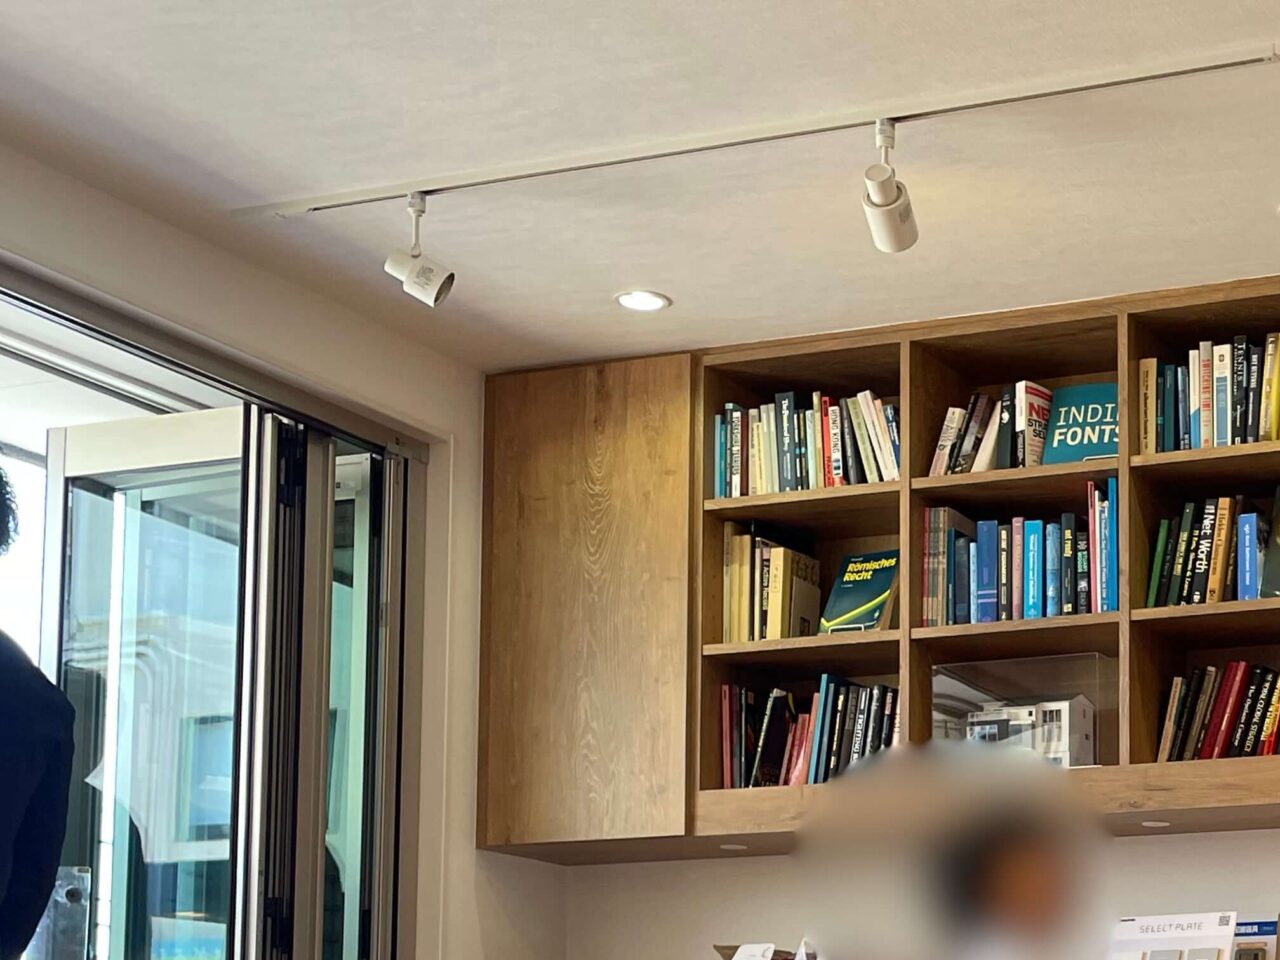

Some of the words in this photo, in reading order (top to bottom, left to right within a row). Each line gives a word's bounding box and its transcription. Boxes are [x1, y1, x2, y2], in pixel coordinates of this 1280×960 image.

[1236, 342, 1245, 381] TENNIS
[830, 409, 838, 430] HONG
[1056, 404, 1119, 425] INDI
[831, 432, 839, 453] KONG
[1200, 514, 1213, 536] Net
[847, 557, 897, 572] Römisches
[1195, 538, 1211, 573] Worth
[843, 571, 872, 582] Recht
[1139, 923, 1172, 934] SELECT
[1175, 922, 1204, 931] PLATE
